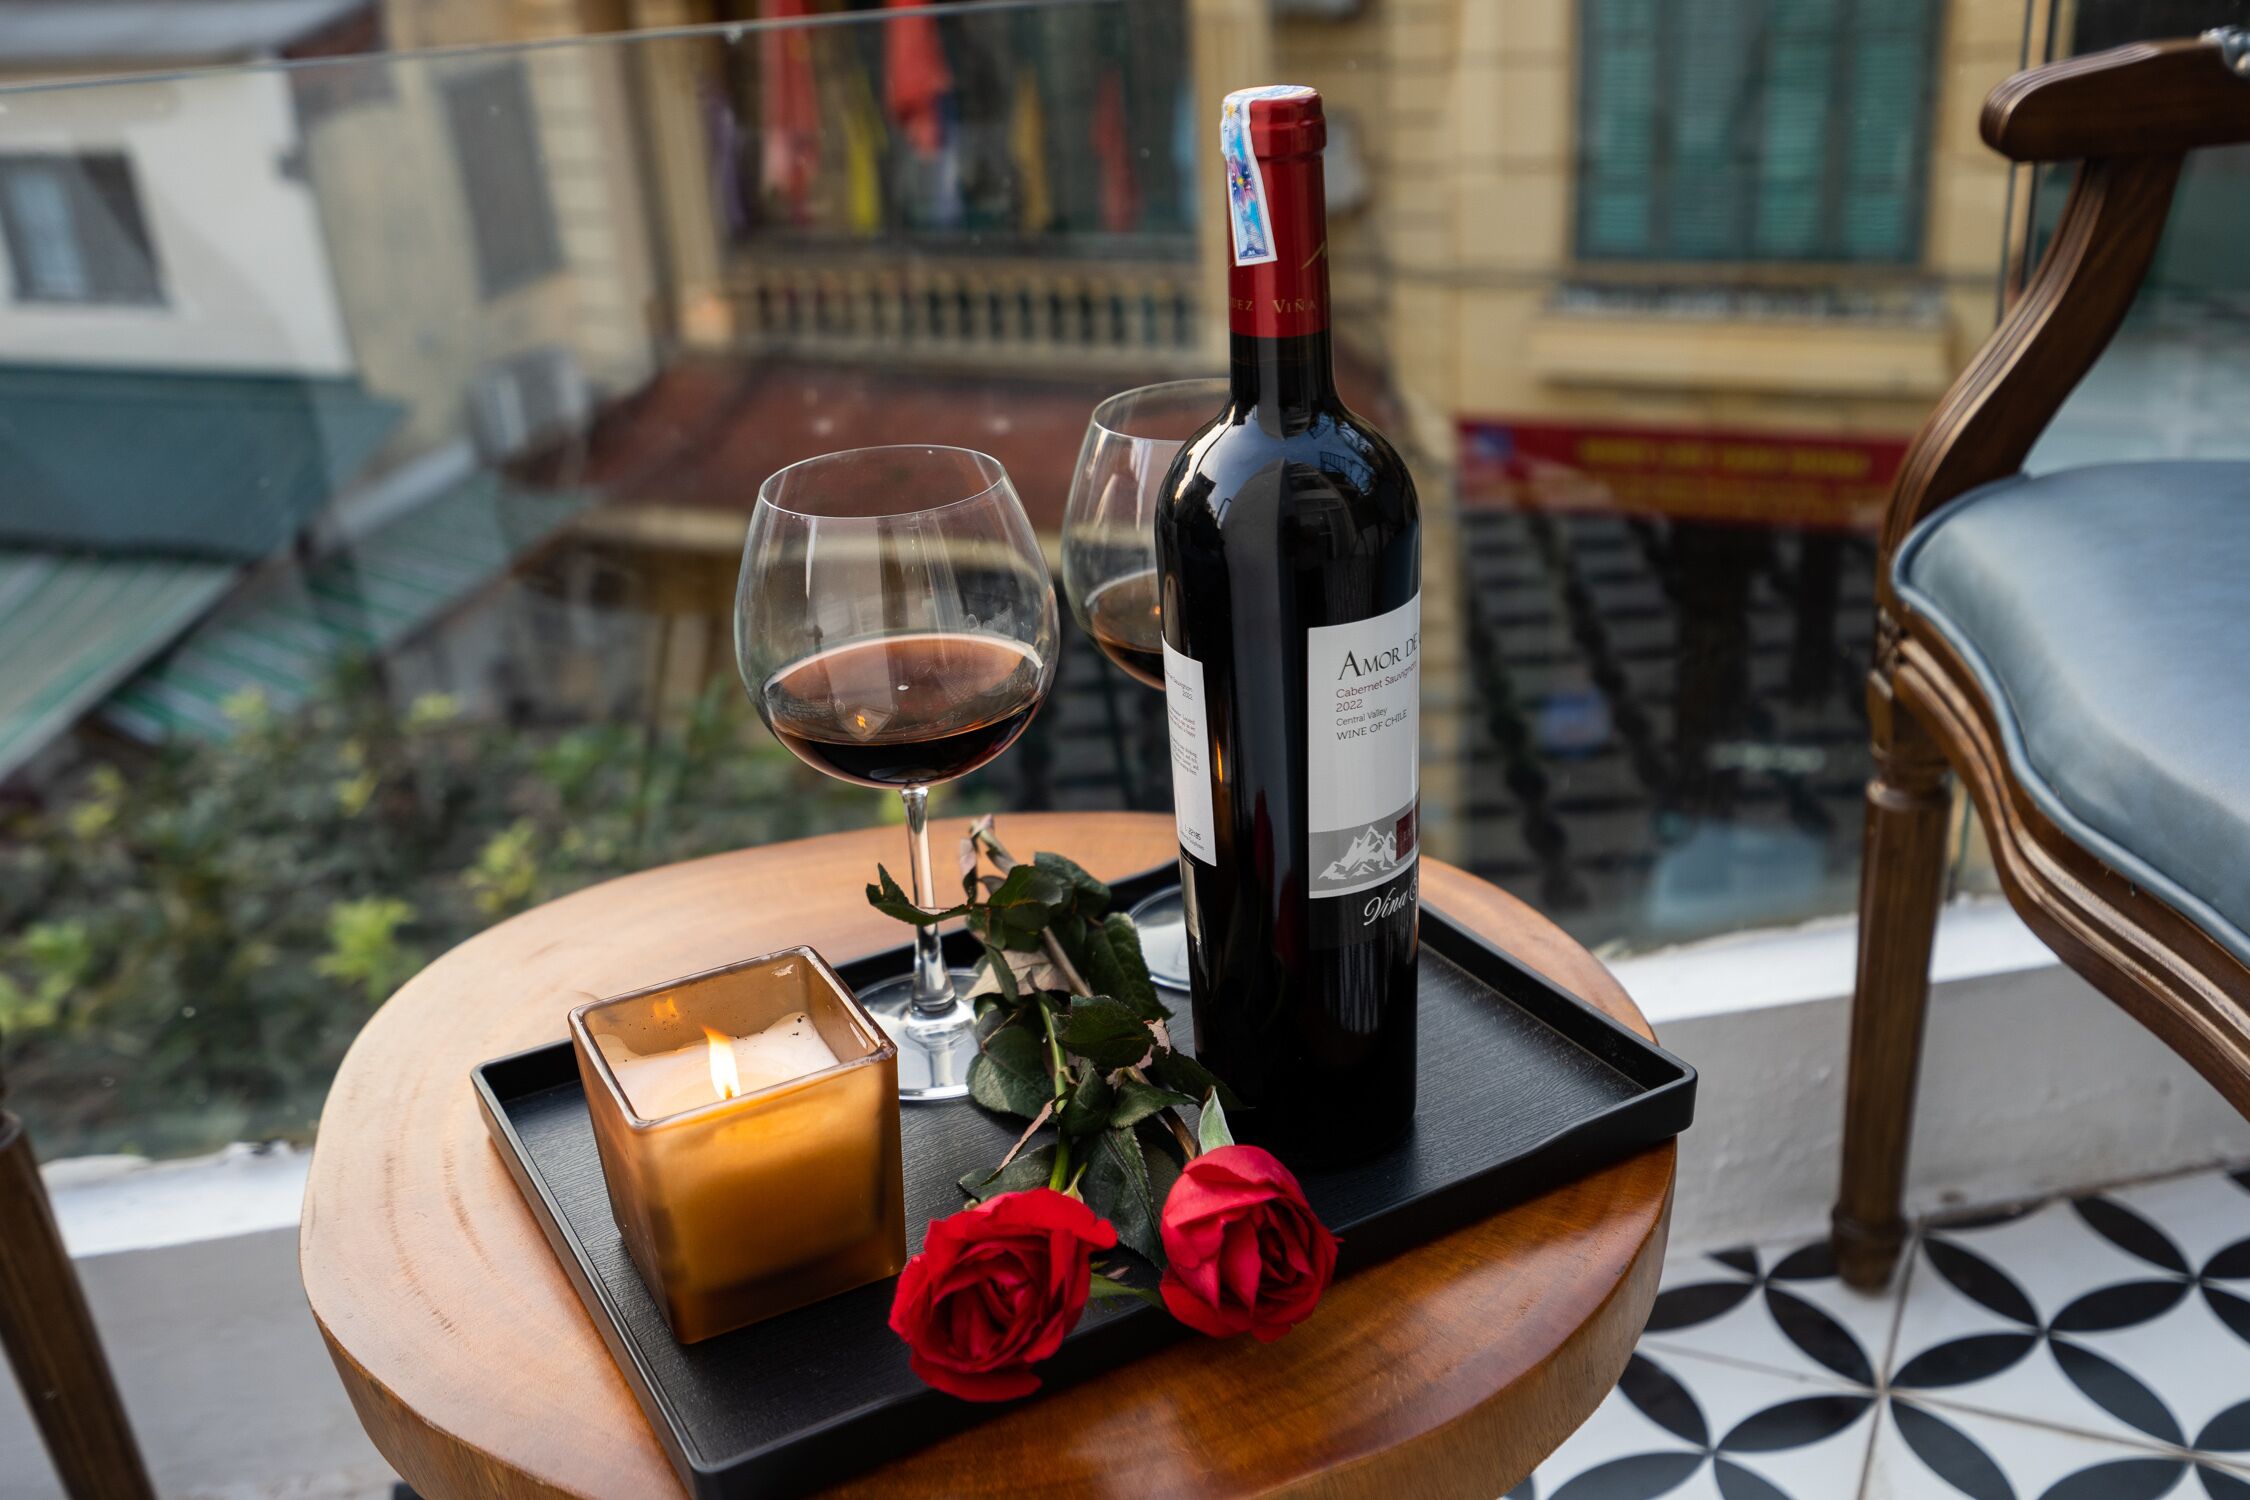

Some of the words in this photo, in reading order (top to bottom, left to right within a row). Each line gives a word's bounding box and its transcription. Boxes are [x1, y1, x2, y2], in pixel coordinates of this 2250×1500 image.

[1337, 648, 1402, 681] AMOR
[1406, 632, 1418, 657] DE
[1336, 680, 1383, 698] Cabernet
[1336, 699, 1363, 713] 2022
[1336, 714, 1366, 727] Central
[1367, 707, 1388, 719] Valley
[1336, 727, 1367, 741] WINE
[1370, 721, 1384, 733] OF
[1385, 709, 1408, 728] CHILE
